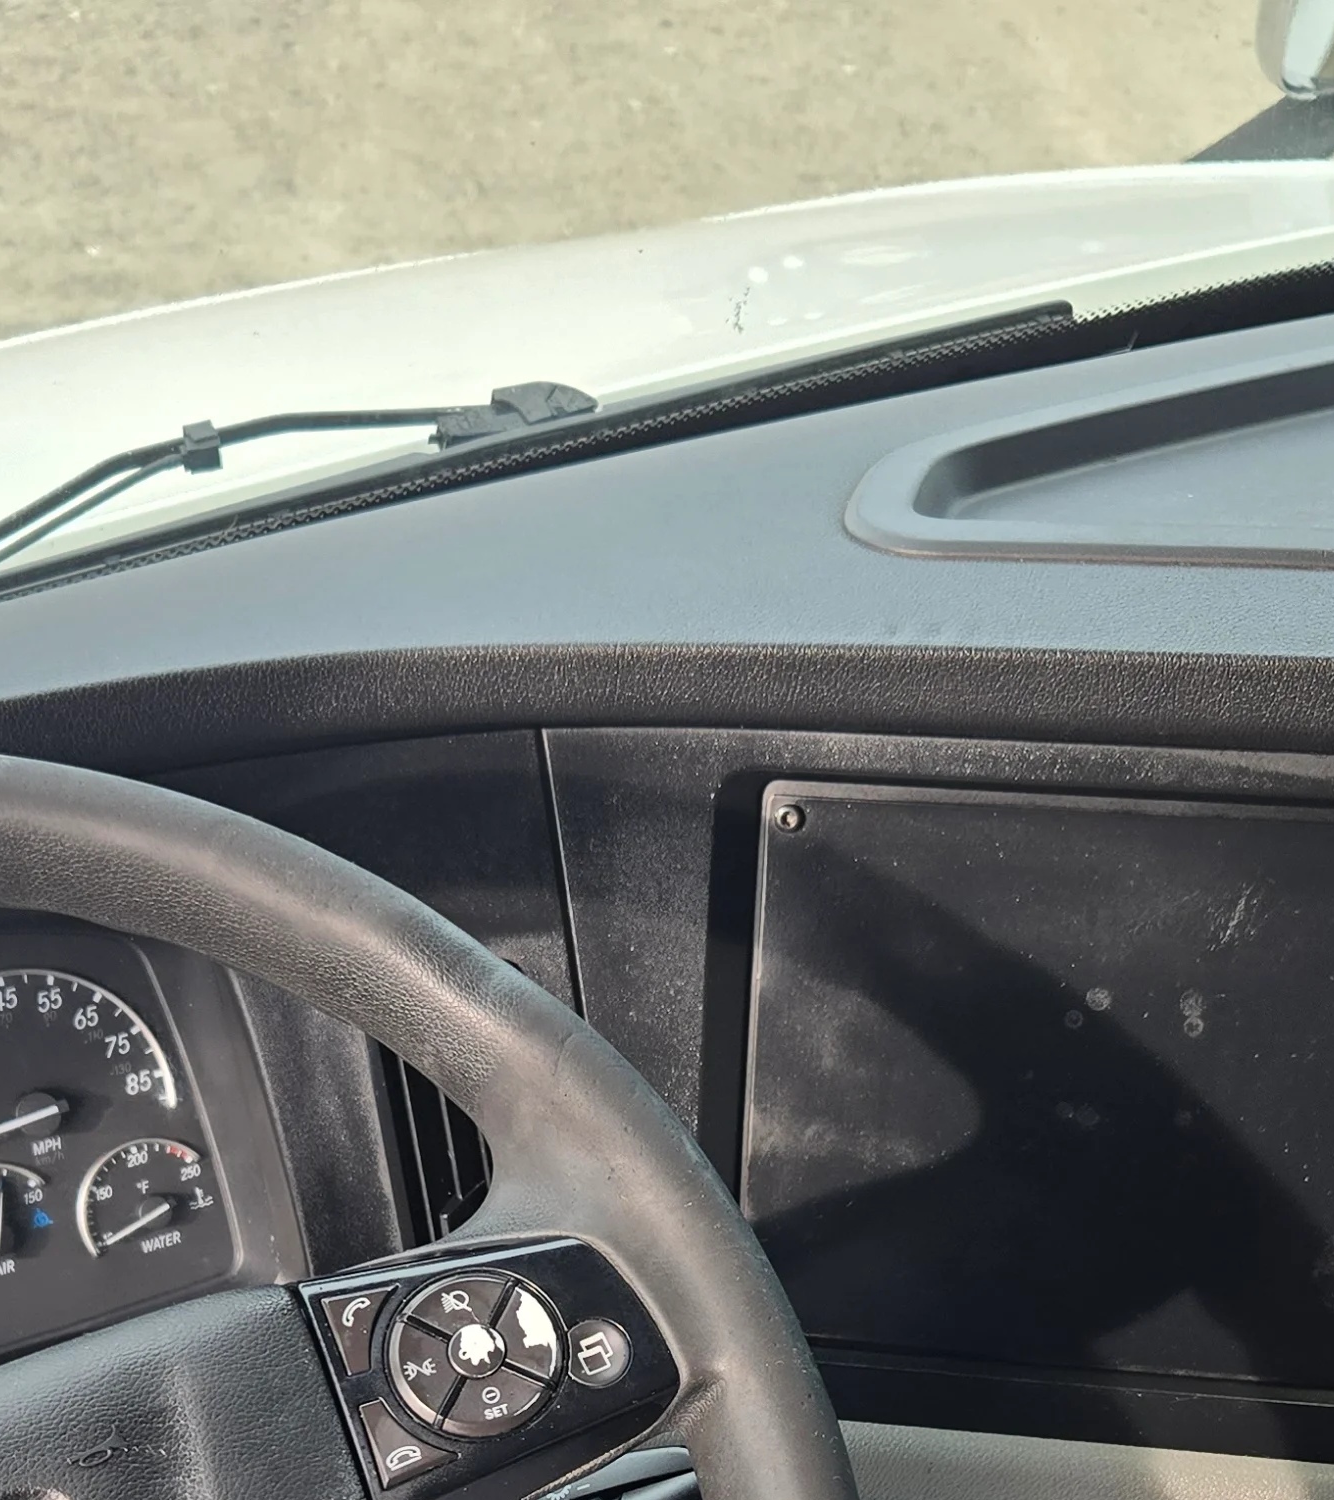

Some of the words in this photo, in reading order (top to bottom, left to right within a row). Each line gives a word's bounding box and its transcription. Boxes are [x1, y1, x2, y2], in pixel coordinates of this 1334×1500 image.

[37, 988, 63, 1013] 55
[74, 1006, 99, 1030] 65
[104, 1033, 131, 1059] 75
[124, 1069, 152, 1096] 85
[32, 1136, 62, 1156] MPH
[127, 1151, 148, 1168] 200
[180, 1164, 201, 1182] 250
[24, 1189, 43, 1205] 150
[95, 1185, 113, 1201] 150
[141, 1230, 182, 1254] WATER
[483, 1403, 508, 1421] SET
